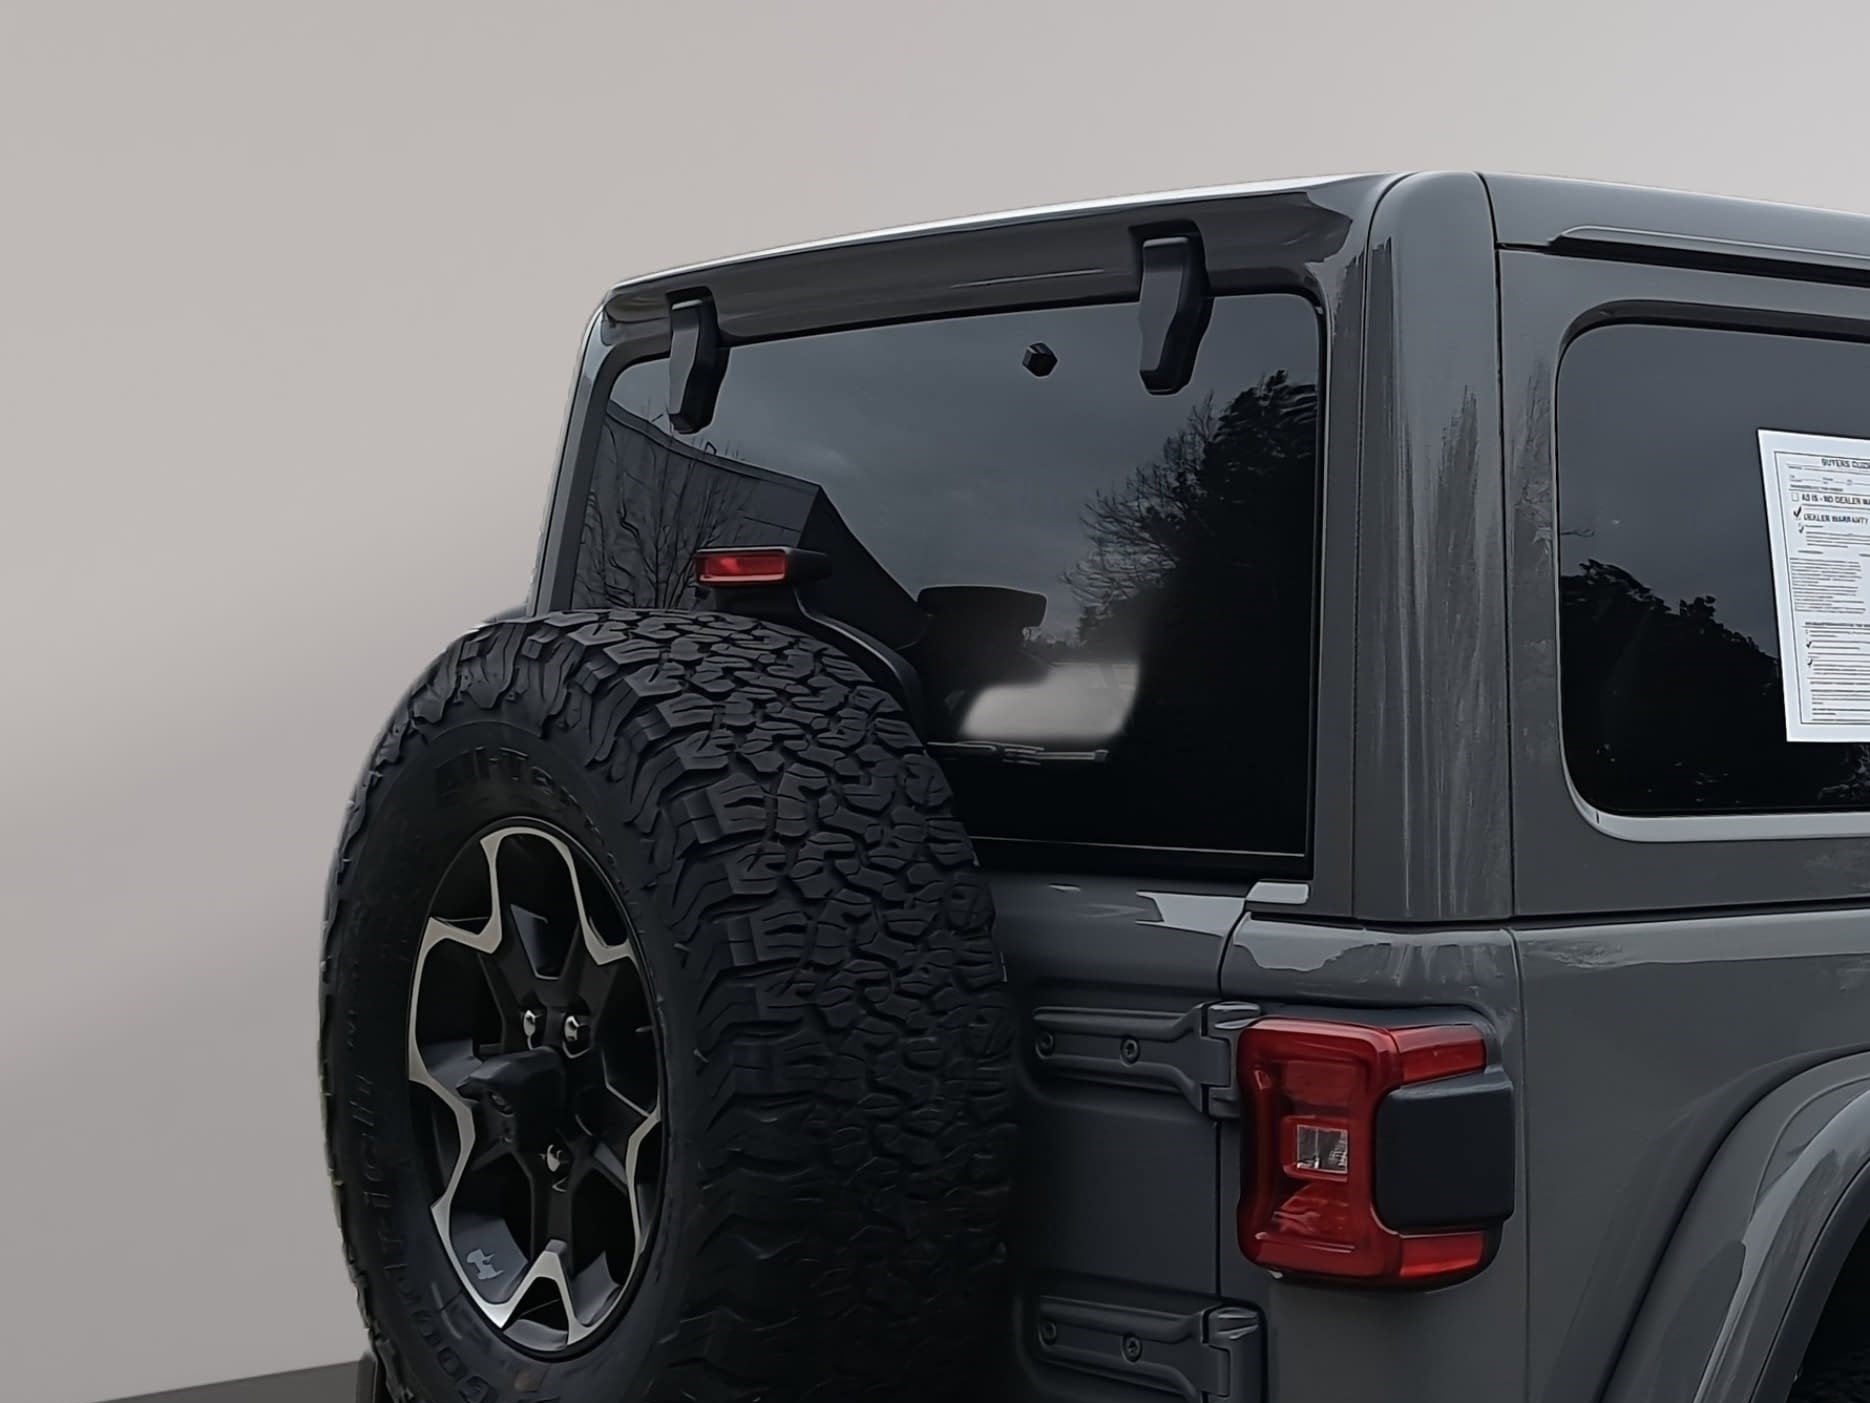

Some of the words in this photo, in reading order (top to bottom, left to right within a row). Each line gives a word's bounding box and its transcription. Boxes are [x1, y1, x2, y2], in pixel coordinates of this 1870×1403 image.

[1820, 458, 1850, 468] BUYERS
[1823, 495, 1834, 503] NO
[1834, 495, 1861, 505] DEALER
[1803, 513, 1830, 522] DEALER
[1831, 515, 1869, 525] WARRANTY
